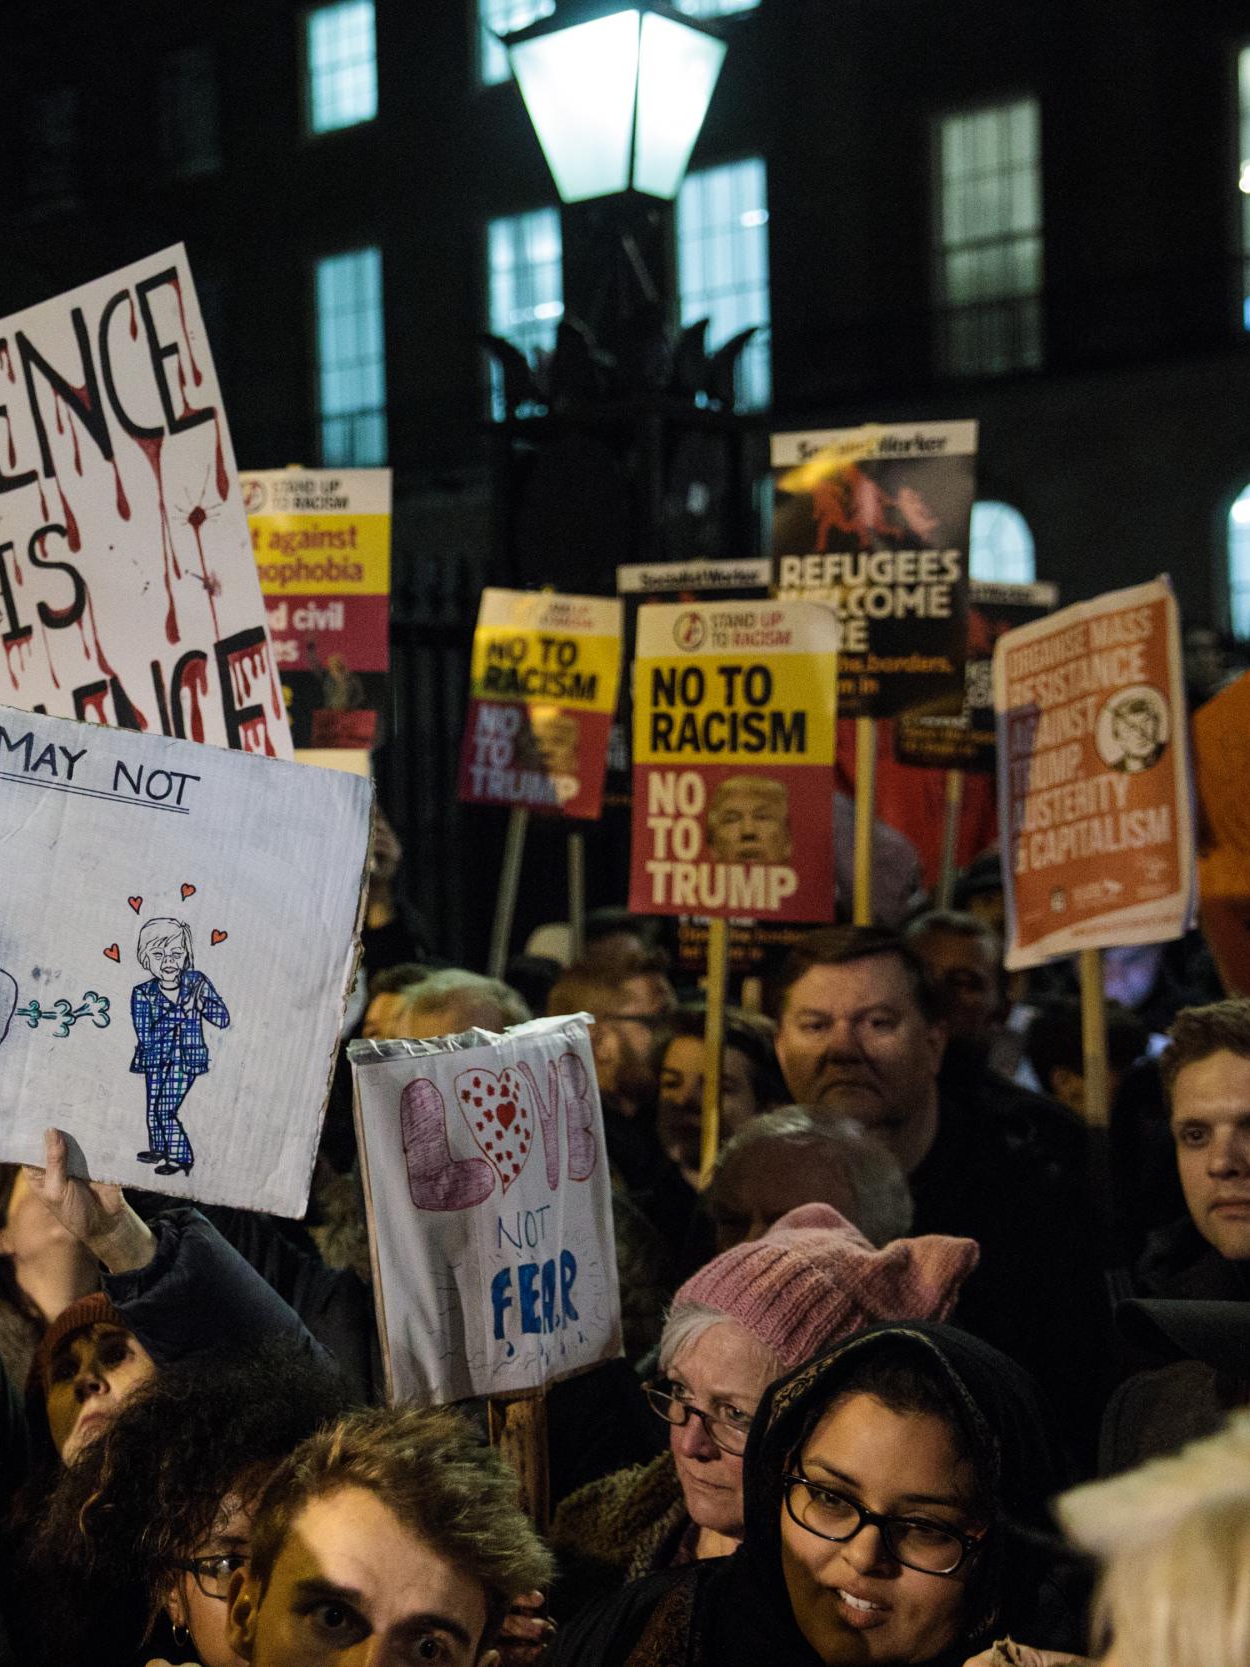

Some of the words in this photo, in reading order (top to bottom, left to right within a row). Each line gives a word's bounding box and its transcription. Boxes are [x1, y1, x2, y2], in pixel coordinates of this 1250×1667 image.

[269, 523, 357, 556] against
[779, 550, 963, 586] REFUGEES
[293, 602, 344, 631] civil
[710, 612, 756, 629] STAND
[759, 612, 784, 628] UP
[540, 638, 578, 668] TO
[711, 631, 728, 647] TO
[732, 630, 792, 646] RACISM
[484, 665, 598, 700] RACISM
[652, 666, 705, 708] NO
[717, 665, 773, 706] TO
[478, 704, 521, 733] NO
[651, 711, 807, 754] RACISM
[113, 760, 202, 806] NOT
[470, 764, 581, 806] TRUMP
[648, 770, 706, 817] NO
[647, 815, 701, 861] TO
[1030, 804, 1171, 871] CAPITALISM
[645, 861, 799, 913] TRUMP
[497, 1205, 551, 1250] NOT
[491, 1248, 579, 1340] FEAR
